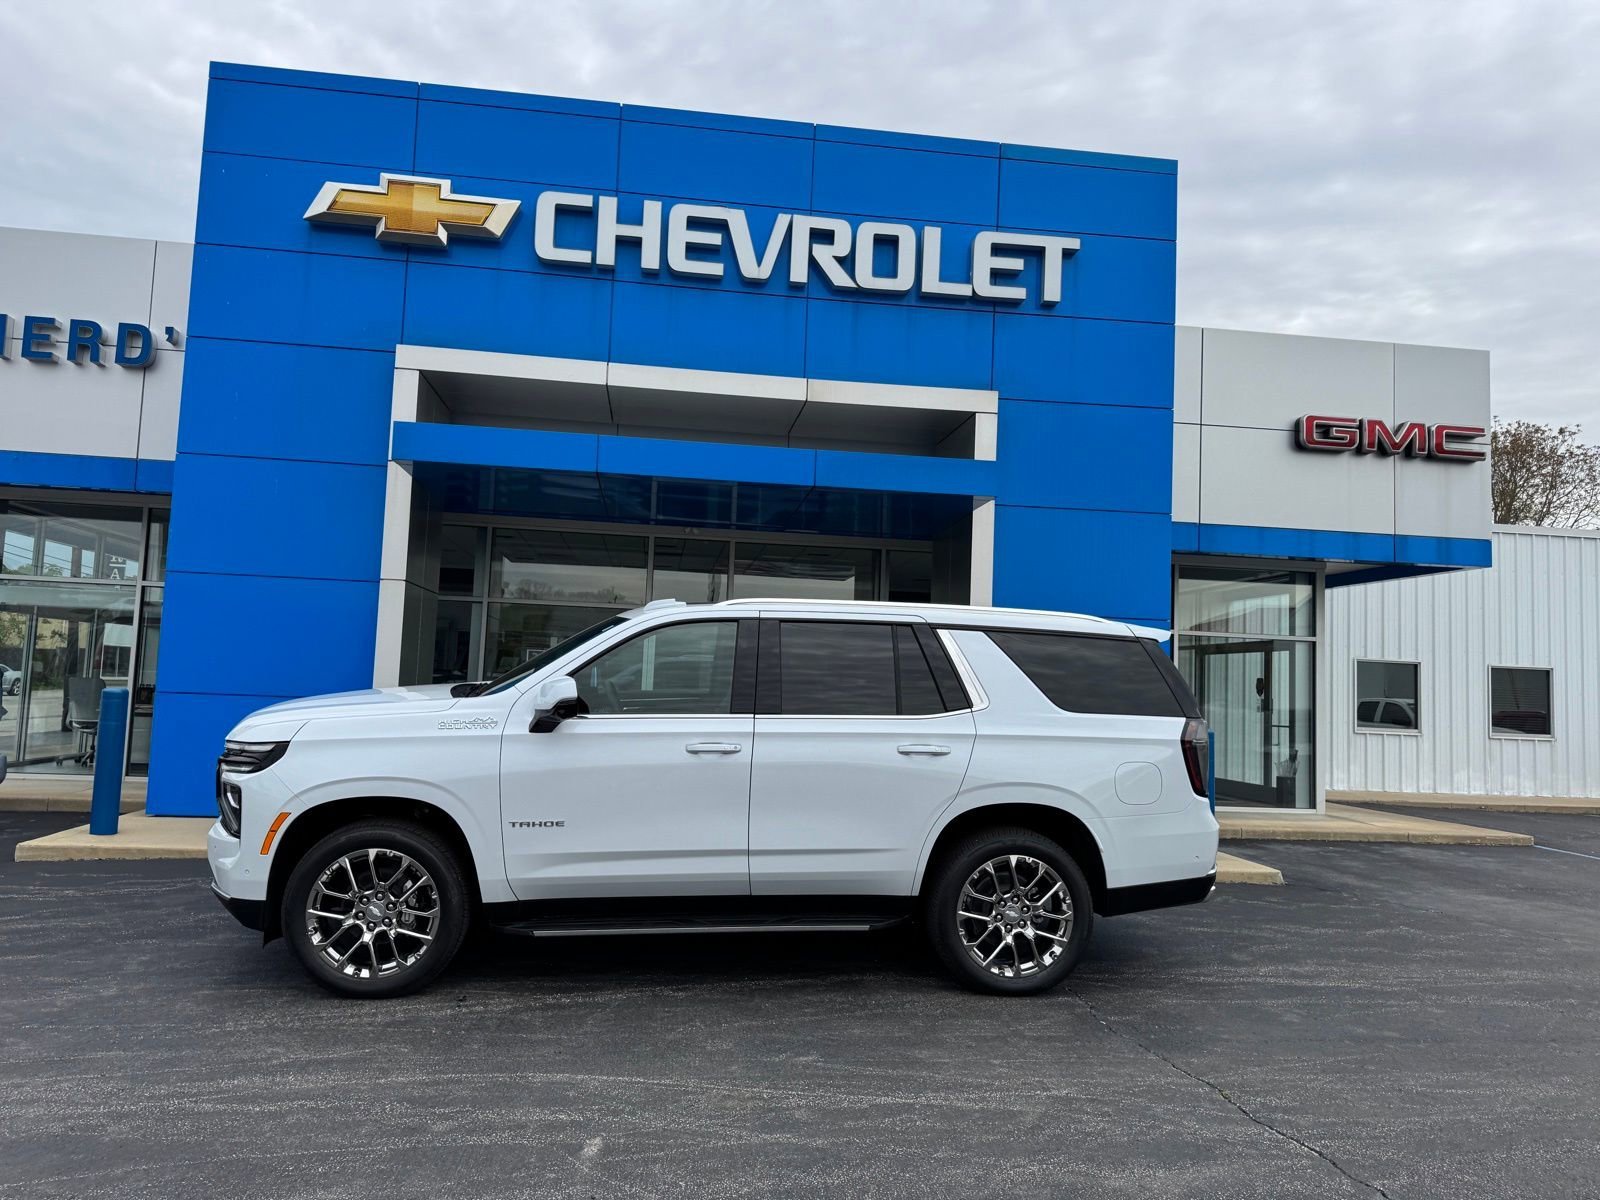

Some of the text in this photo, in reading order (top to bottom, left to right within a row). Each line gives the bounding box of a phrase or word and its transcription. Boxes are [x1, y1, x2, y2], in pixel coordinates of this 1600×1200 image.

[534, 190, 1081, 305] CHEVROLET
[0, 313, 178, 367] ERD'
[1300, 414, 1486, 461] GMC
[508, 820, 566, 829] TAHOE
